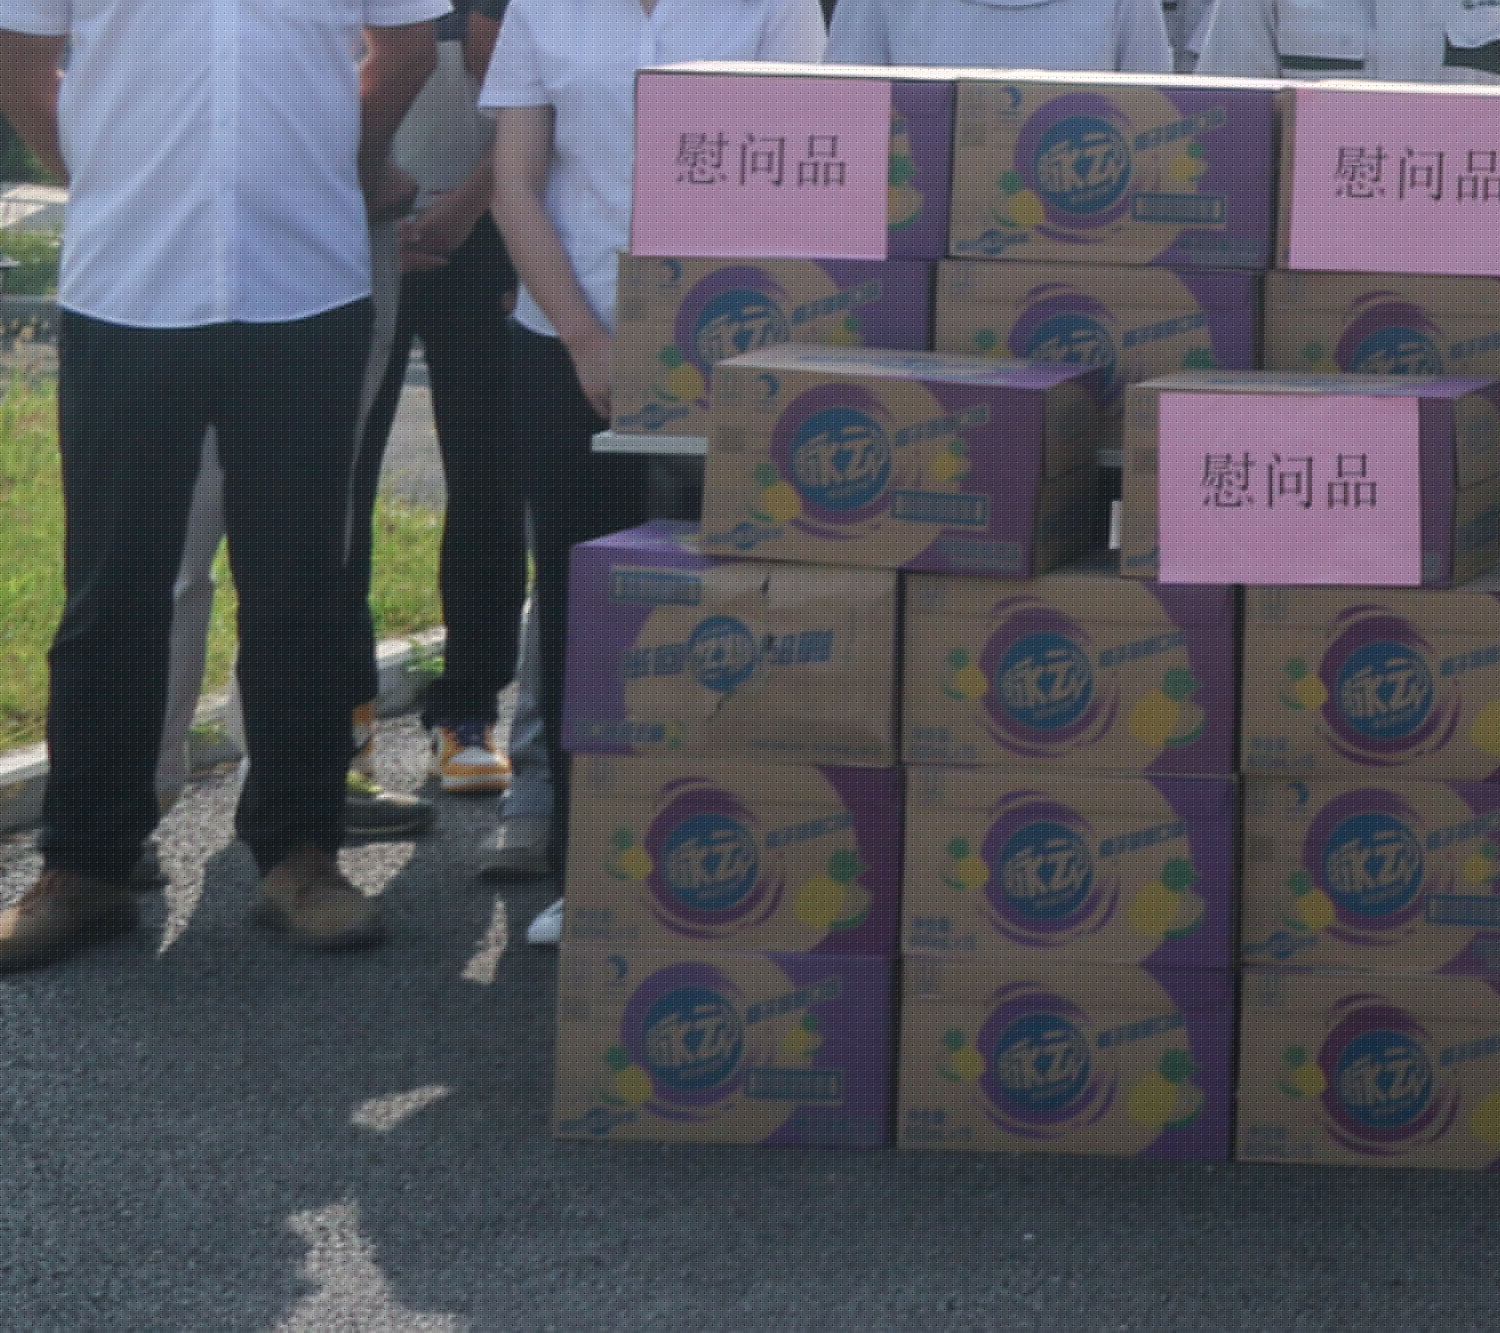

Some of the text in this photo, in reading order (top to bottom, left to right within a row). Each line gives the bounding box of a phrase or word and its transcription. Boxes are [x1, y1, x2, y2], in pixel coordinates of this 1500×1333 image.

[675, 131, 847, 187] 慰问品
[1202, 452, 1379, 510] 慰问品
